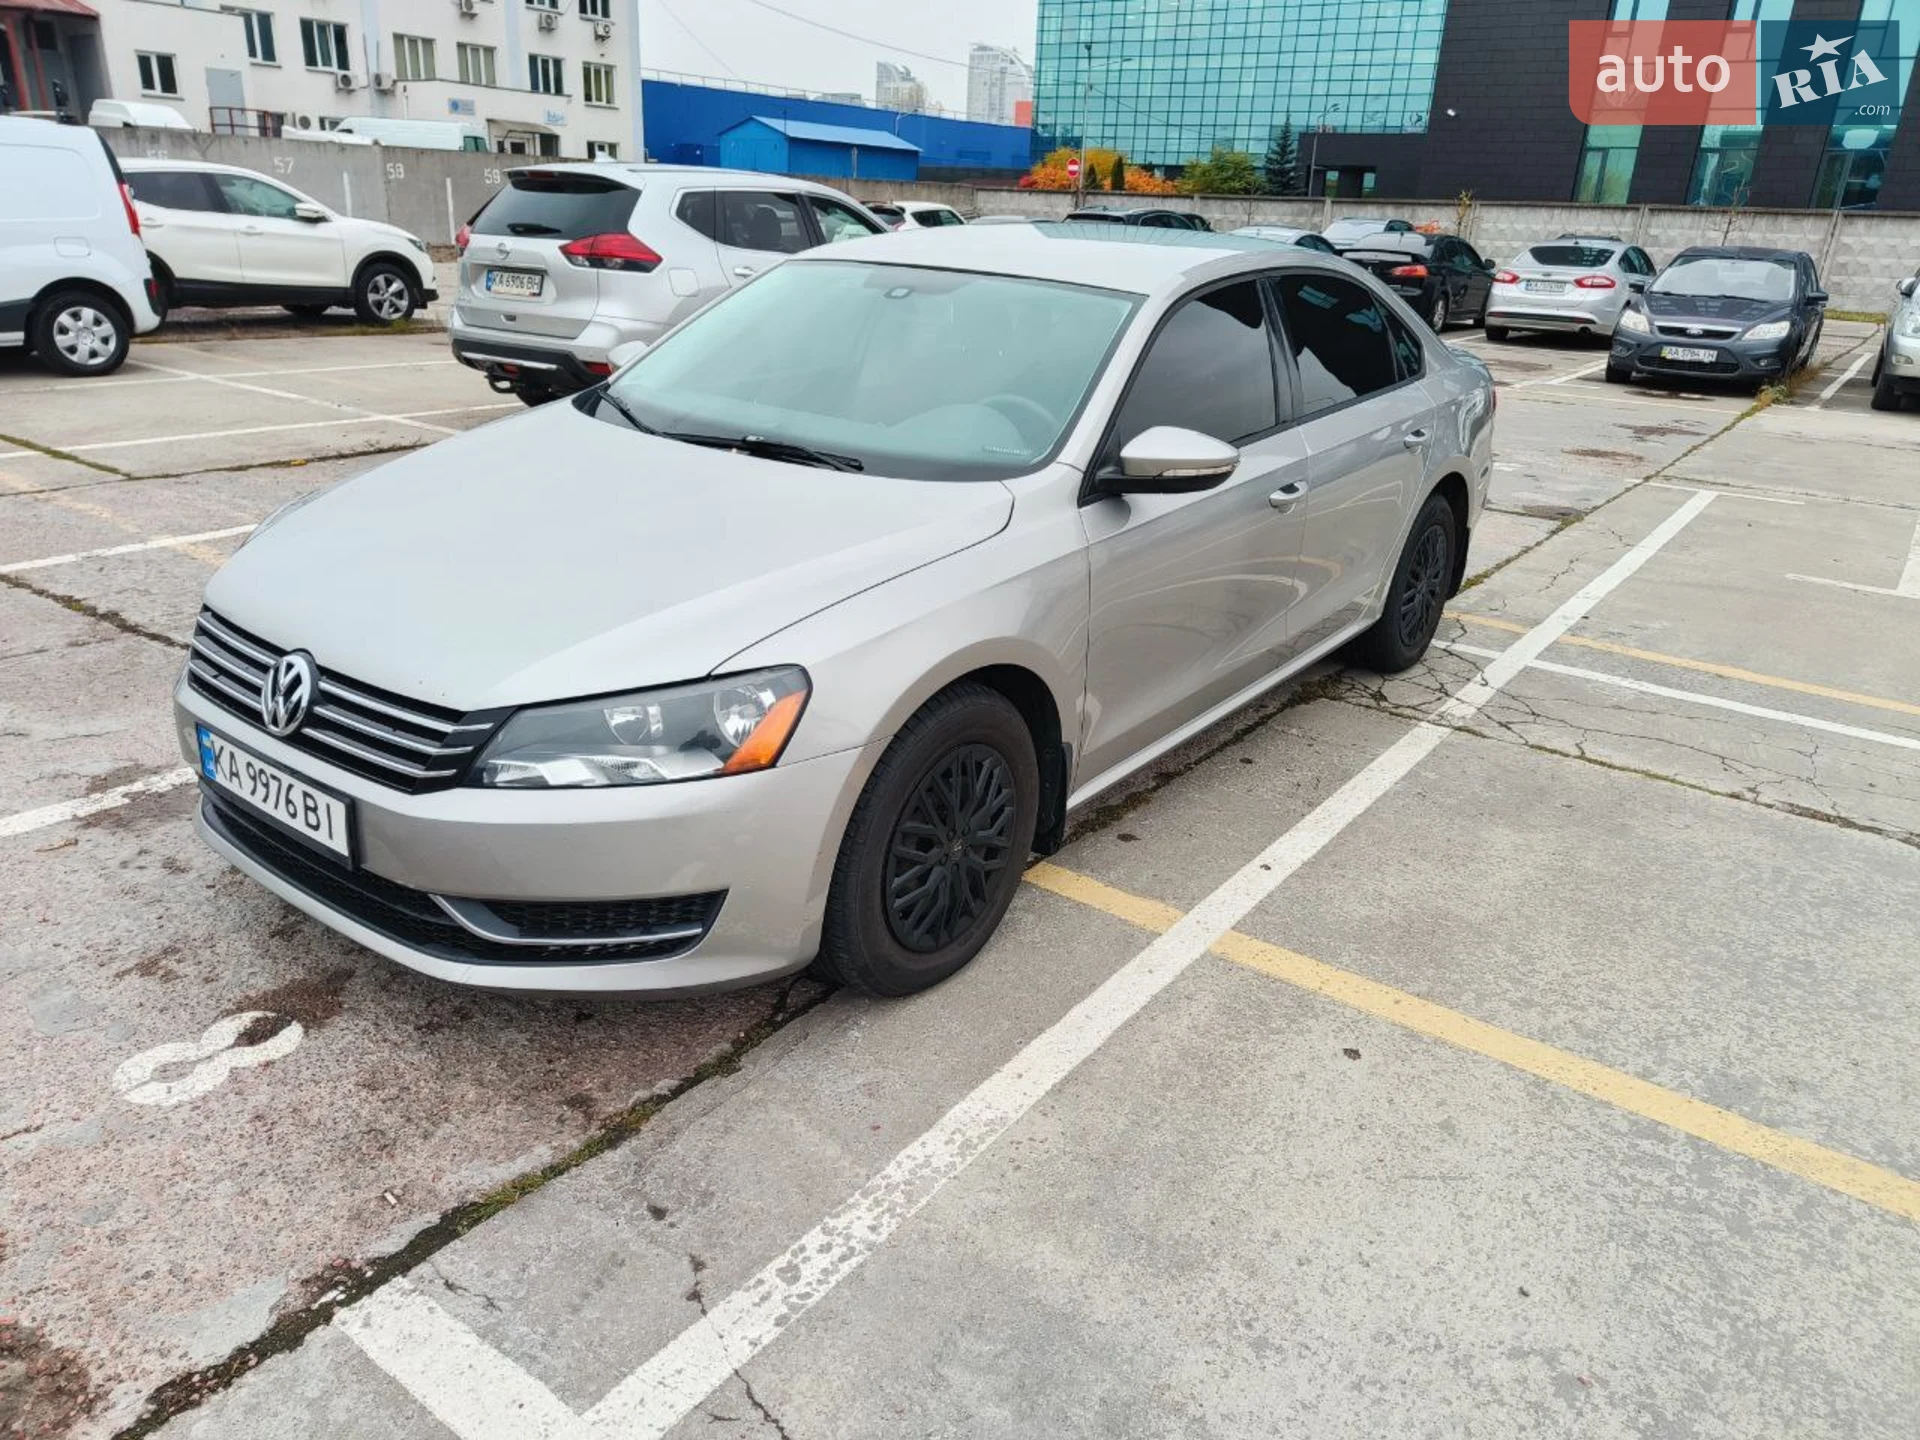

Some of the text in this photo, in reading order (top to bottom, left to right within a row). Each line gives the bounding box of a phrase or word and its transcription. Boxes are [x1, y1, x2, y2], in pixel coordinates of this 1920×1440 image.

[273, 157, 294, 175] 57
[386, 163, 405, 180] 58
[483, 168, 501, 184] 59
[211, 739, 334, 841] KA 9976 BI
